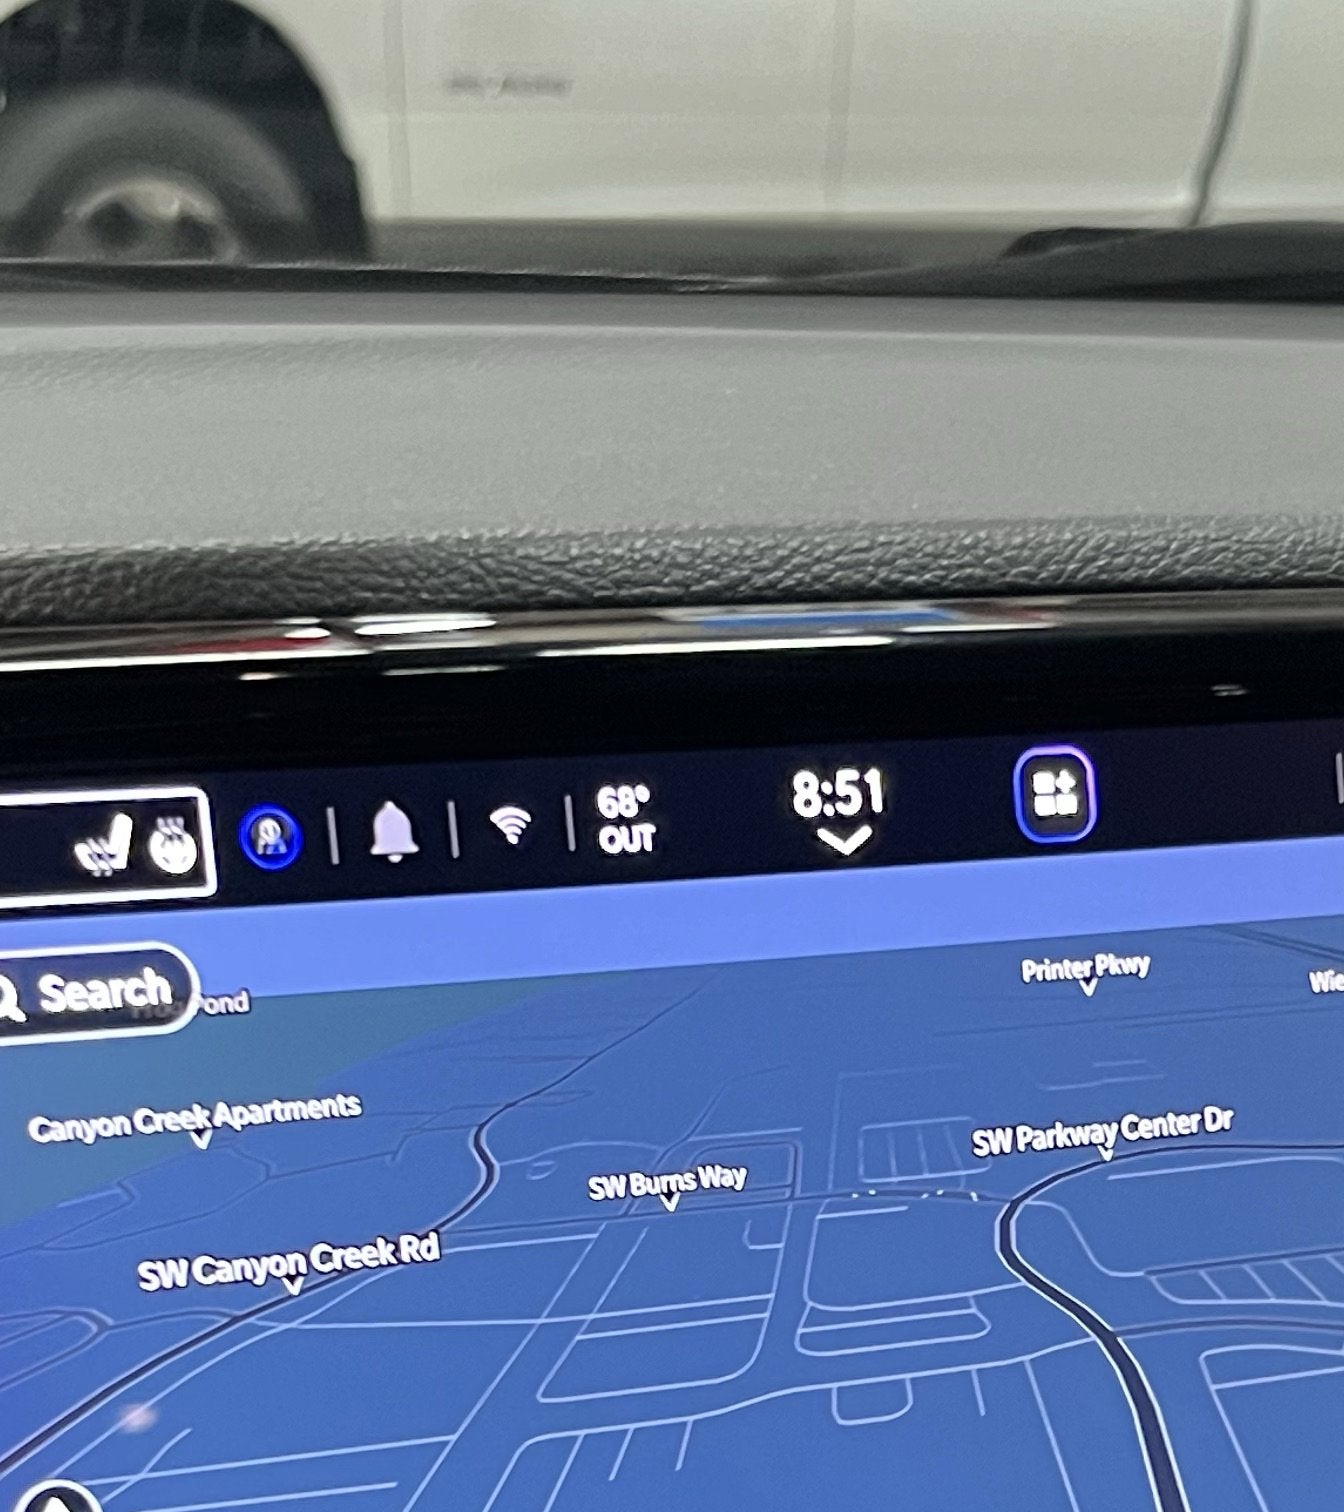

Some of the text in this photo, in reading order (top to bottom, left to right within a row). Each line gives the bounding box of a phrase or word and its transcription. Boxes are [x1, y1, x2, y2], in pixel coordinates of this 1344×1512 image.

[793, 767, 883, 818] 8:51
[599, 823, 656, 854] OUT
[38, 966, 173, 1013] Search
[1021, 953, 1151, 984] Printer Pkwy
[28, 1093, 362, 1145] Canyon Creek Apartments
[972, 1105, 1235, 1157] SW Parkway Center Dr
[588, 1164, 748, 1201] SW Burns Way
[137, 1229, 442, 1292] SW Canyon Creek Rd
